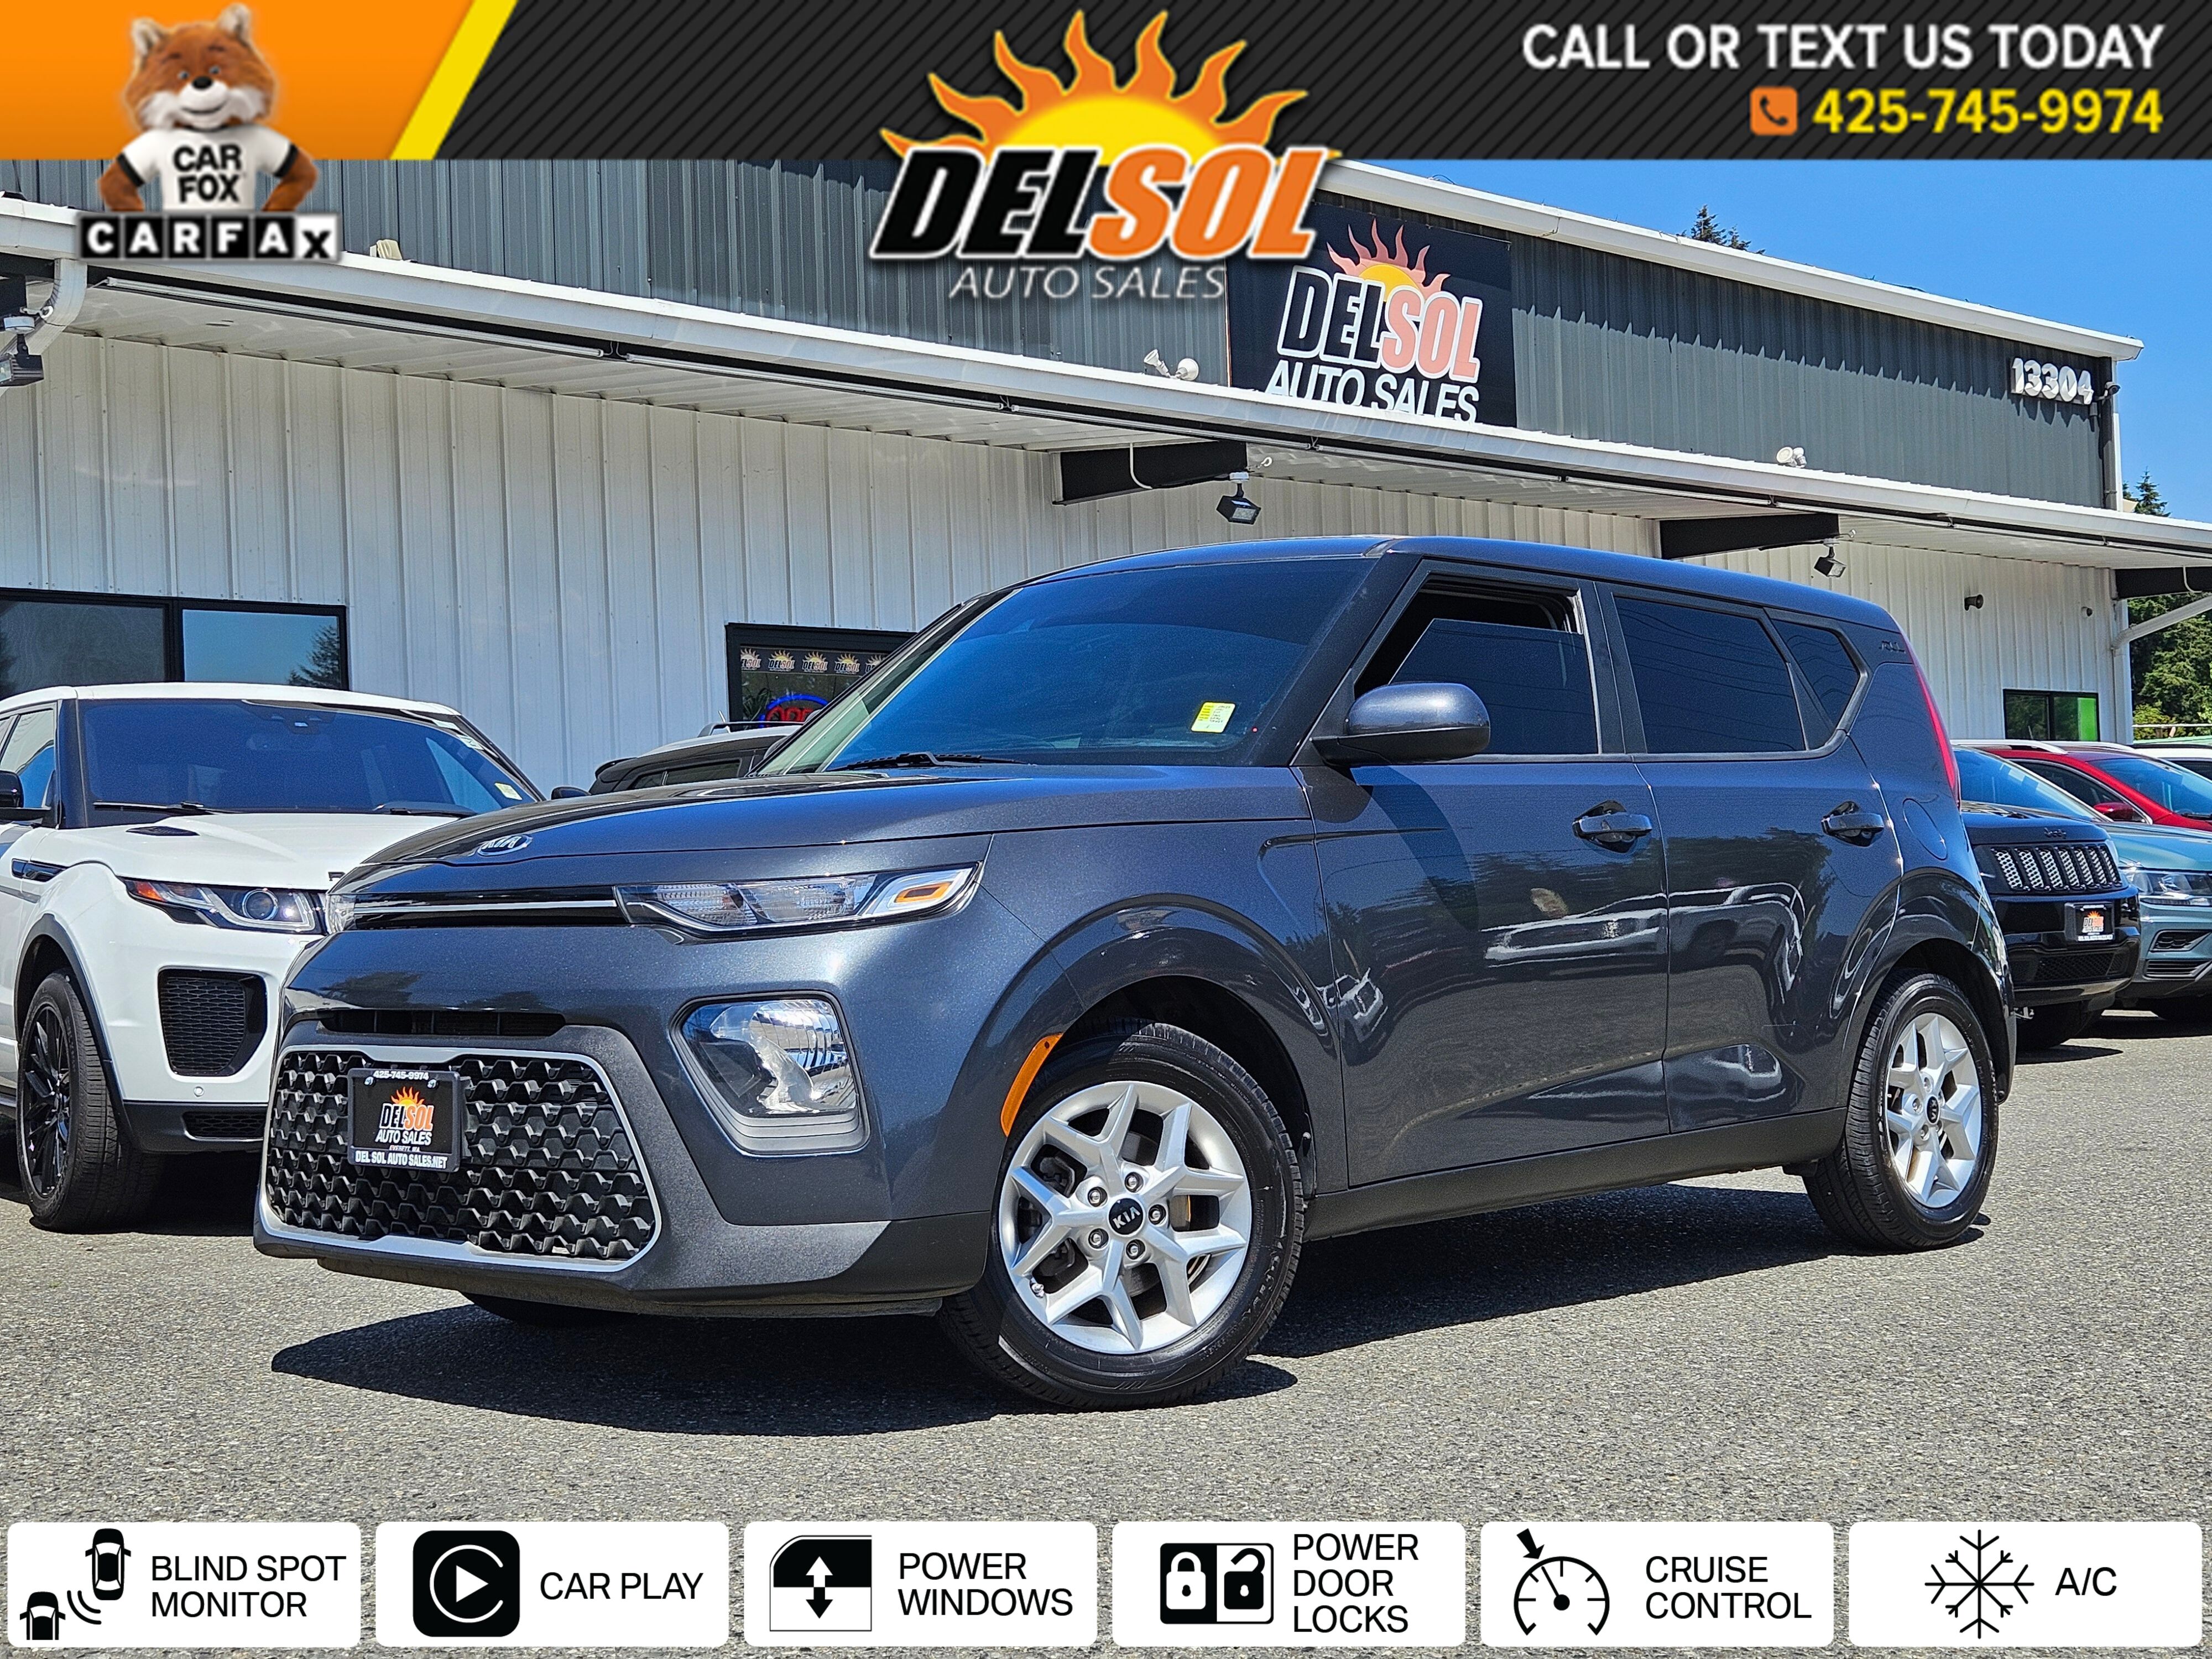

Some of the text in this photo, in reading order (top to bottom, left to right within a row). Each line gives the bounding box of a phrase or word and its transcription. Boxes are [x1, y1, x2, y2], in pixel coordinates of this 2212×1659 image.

[2012, 357, 2094, 405] 13304
[1265, 359, 1480, 423] AUTO SALES
[766, 706, 813, 721] OP
[481, 836, 522, 849] KIA
[373, 1070, 429, 1080] 425-745-9974
[375, 1129, 432, 1145] AUTO SALES
[355, 1150, 371, 1163] DEL
[371, 1151, 387, 1165] SOL
[387, 1152, 408, 1166] AUTO
[1113, 1206, 1141, 1229] KIA
